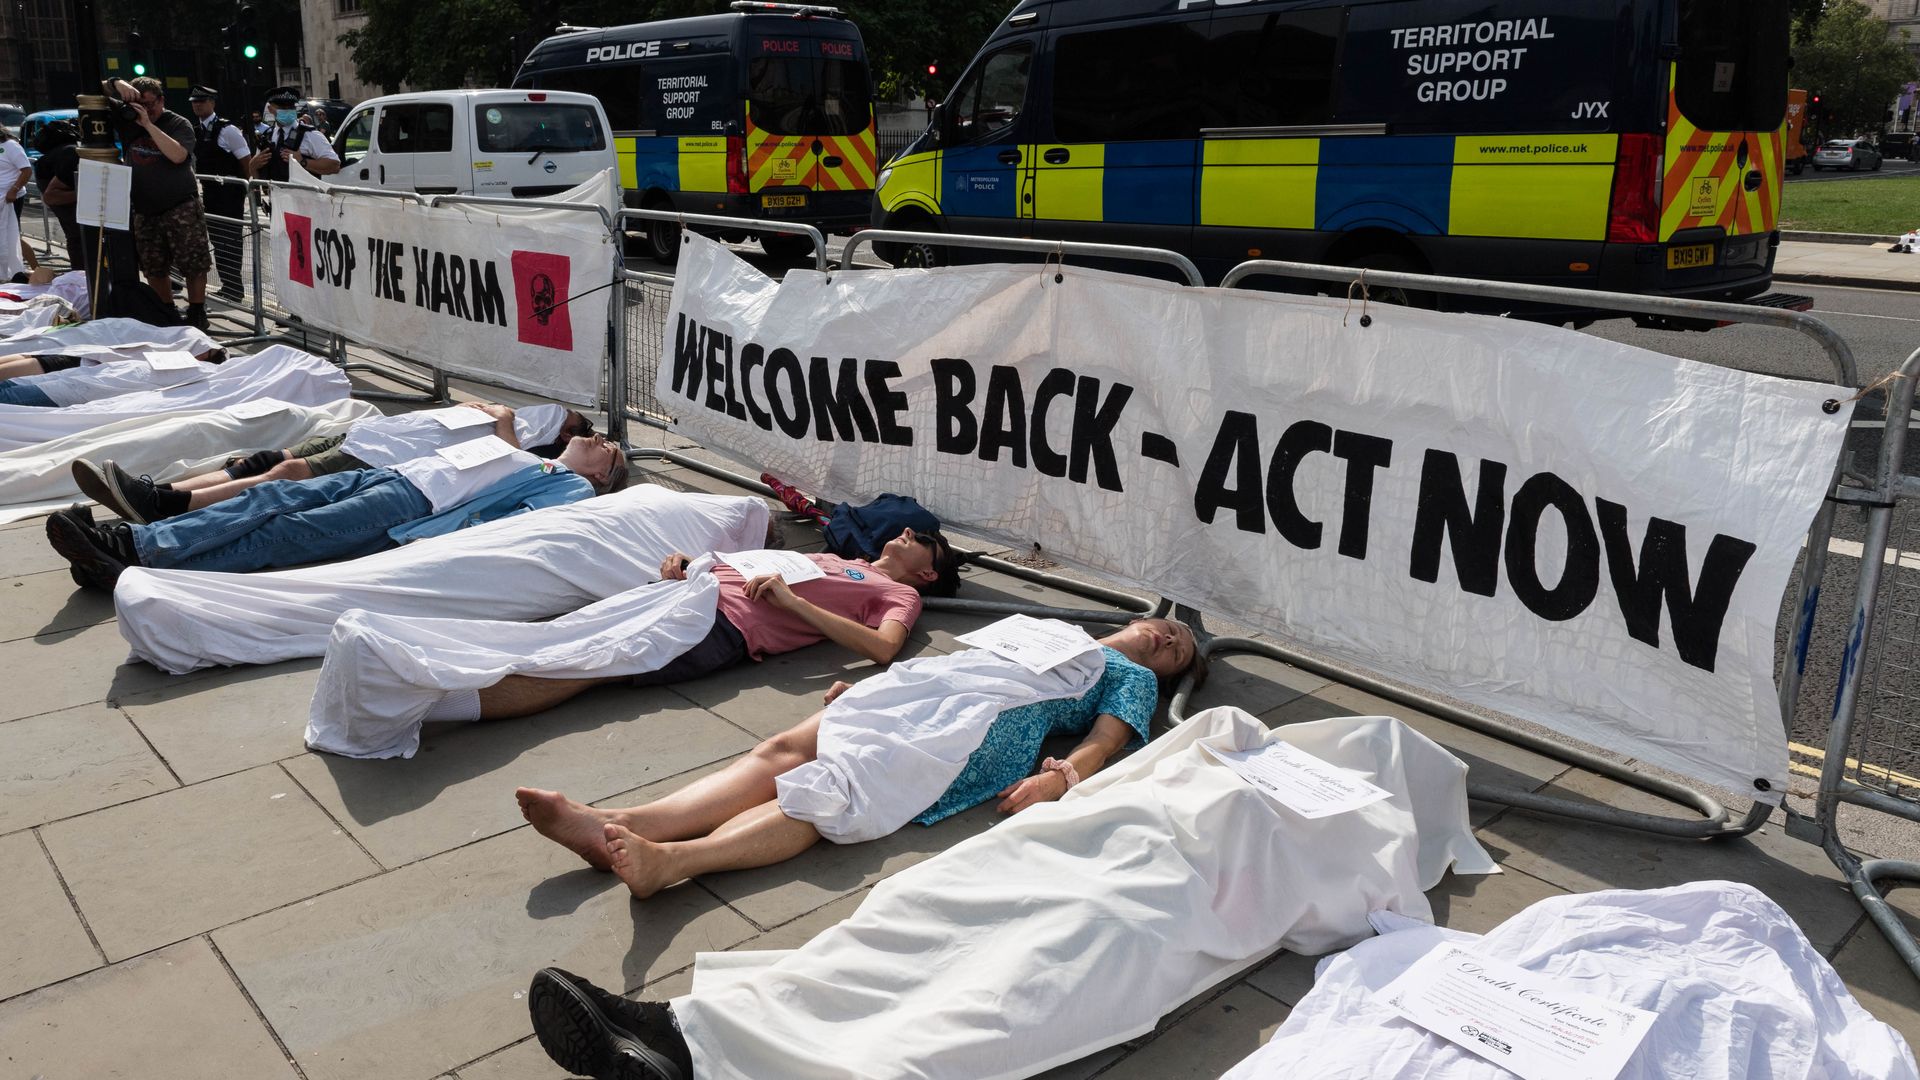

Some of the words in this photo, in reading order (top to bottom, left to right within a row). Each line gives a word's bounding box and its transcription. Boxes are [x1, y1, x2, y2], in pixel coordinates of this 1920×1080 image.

[1390, 17, 1555, 49] TERRITORIAL
[586, 40, 661, 63] POLICE
[762, 39, 800, 52] POLICE
[821, 42, 853, 56] POLICE
[1406, 47, 1528, 76] SUPPORT
[657, 75, 708, 90] TERRITORIAL
[1416, 78, 1507, 103] GROUP
[662, 90, 700, 105] SUPPORT
[666, 106, 695, 119] GROUP
[1571, 101, 1610, 119] JYX
[711, 120, 724, 130] BEL
[1479, 143, 1588, 155] www.met.police.uk
[314, 228, 356, 290] STOP
[367, 237, 406, 304] THE
[412, 246, 508, 327] HARM
[671, 312, 914, 447] WELCOME
[930, 358, 1134, 493] BACK
[1194, 410, 1394, 561] ACT
[1409, 448, 1757, 674] NOW
[1457, 962, 1517, 991] Death
[1518, 989, 1607, 1028] Certificate
